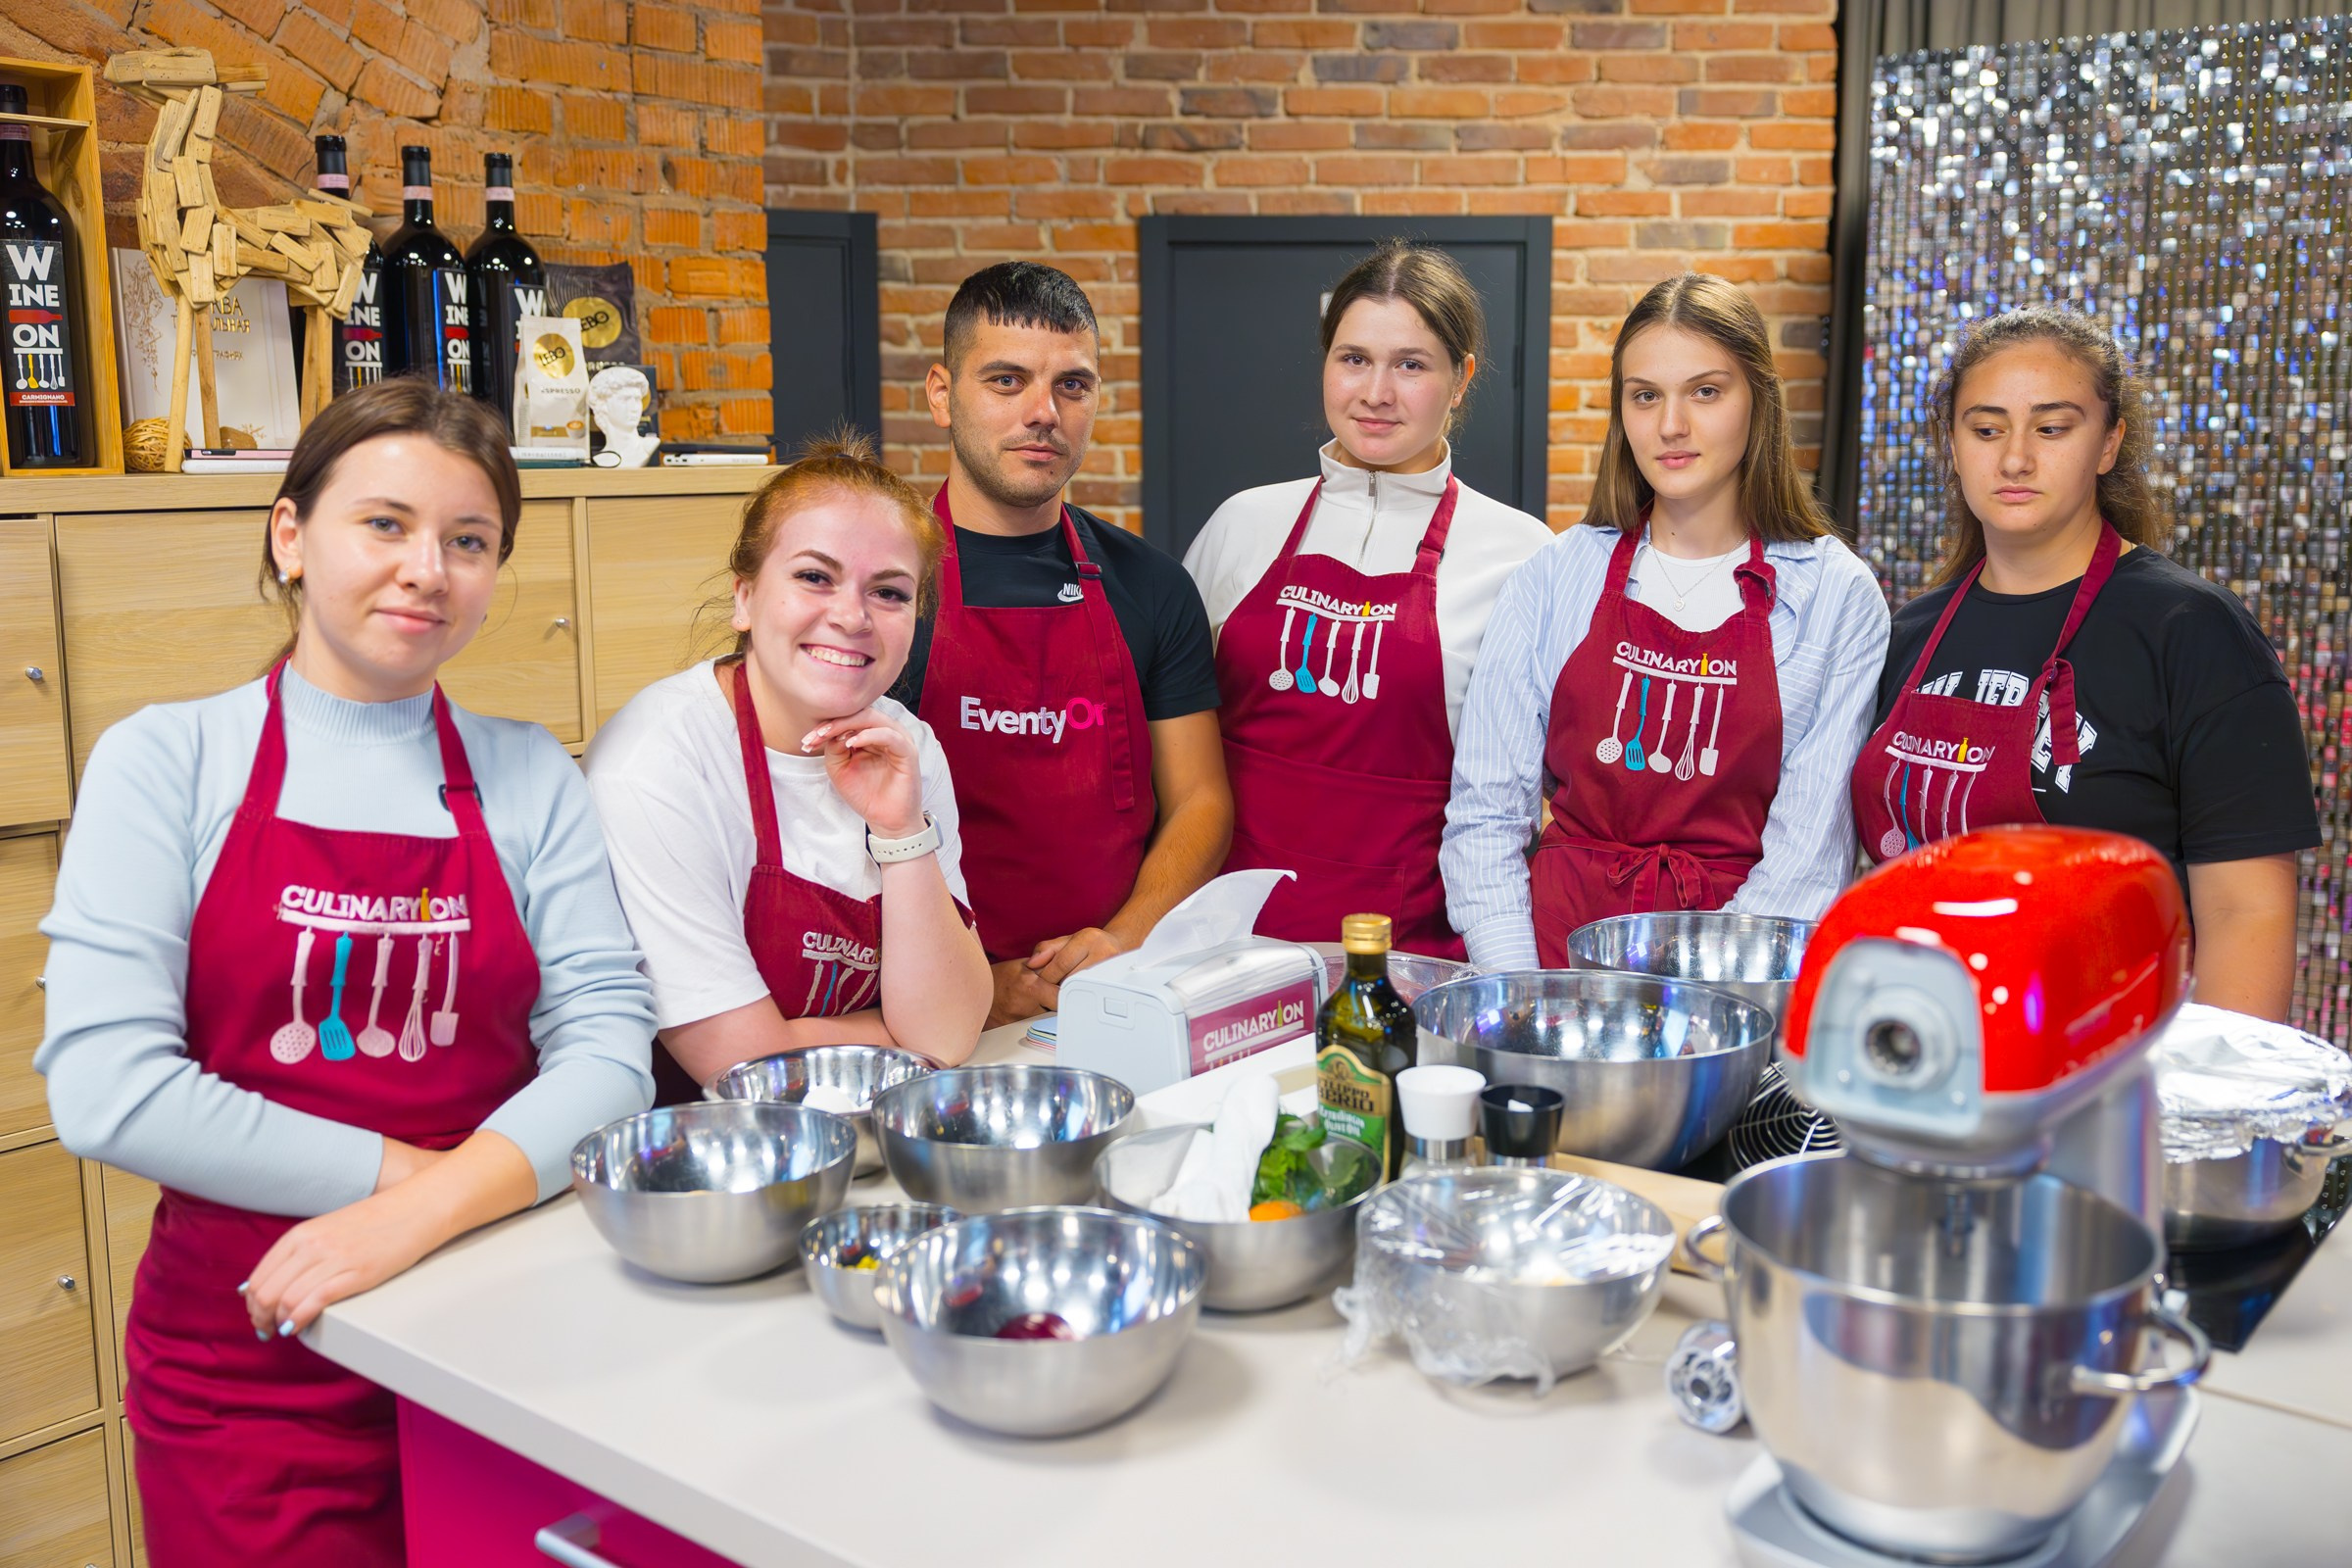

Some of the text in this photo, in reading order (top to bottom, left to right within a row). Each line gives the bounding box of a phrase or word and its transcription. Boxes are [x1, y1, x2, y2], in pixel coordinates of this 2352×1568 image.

[6, 245, 55, 281] W
[8, 284, 61, 307] INE
[580, 311, 610, 332] EBO
[13, 323, 60, 347] ON
[345, 340, 381, 362] ON
[447, 338, 470, 360] ON
[539, 346, 565, 367] LEBO
[1063, 582, 1082, 596] NIK
